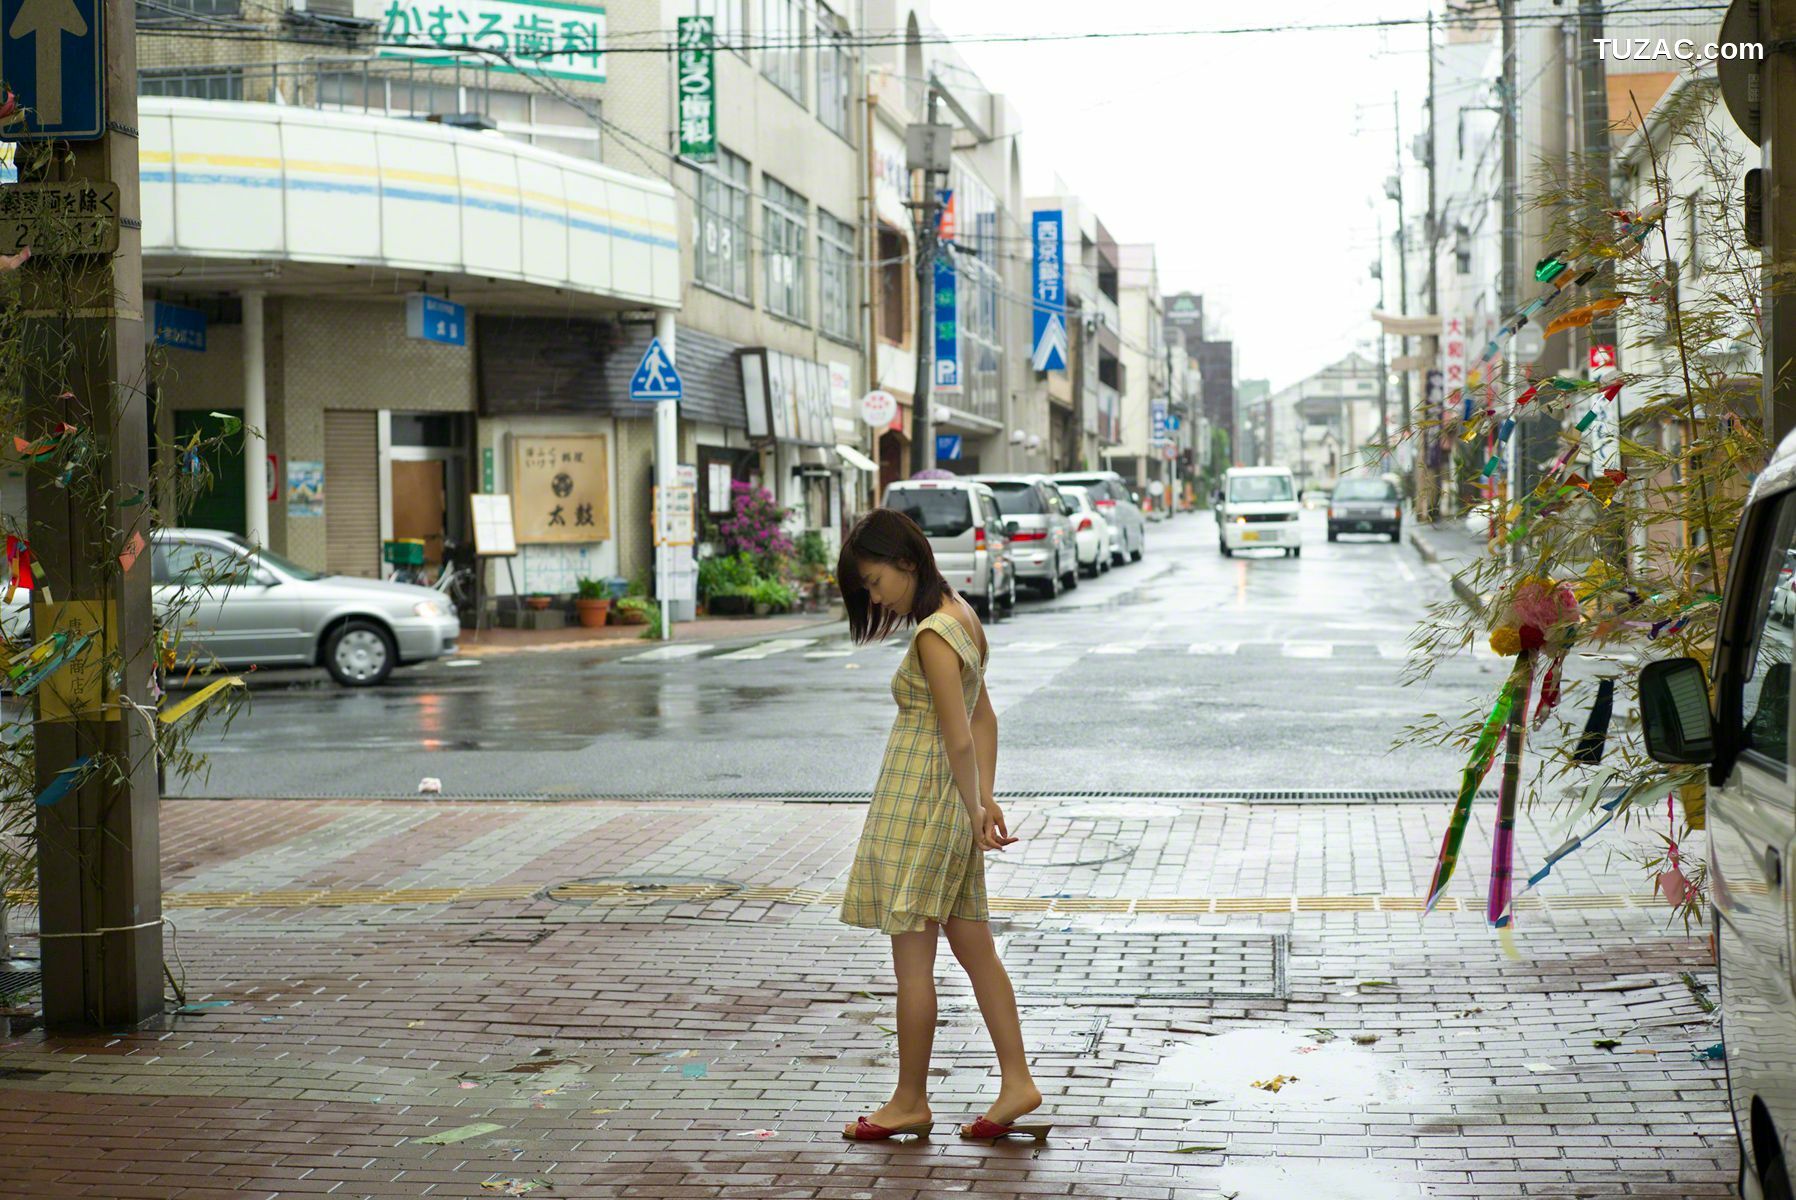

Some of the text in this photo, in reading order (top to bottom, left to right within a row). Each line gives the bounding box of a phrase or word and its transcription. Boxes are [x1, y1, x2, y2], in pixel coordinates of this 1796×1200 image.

[384, 0, 602, 69] かむろ歯科
[680, 17, 712, 145] かむろ歯科
[547, 504, 595, 527] 太鼓
